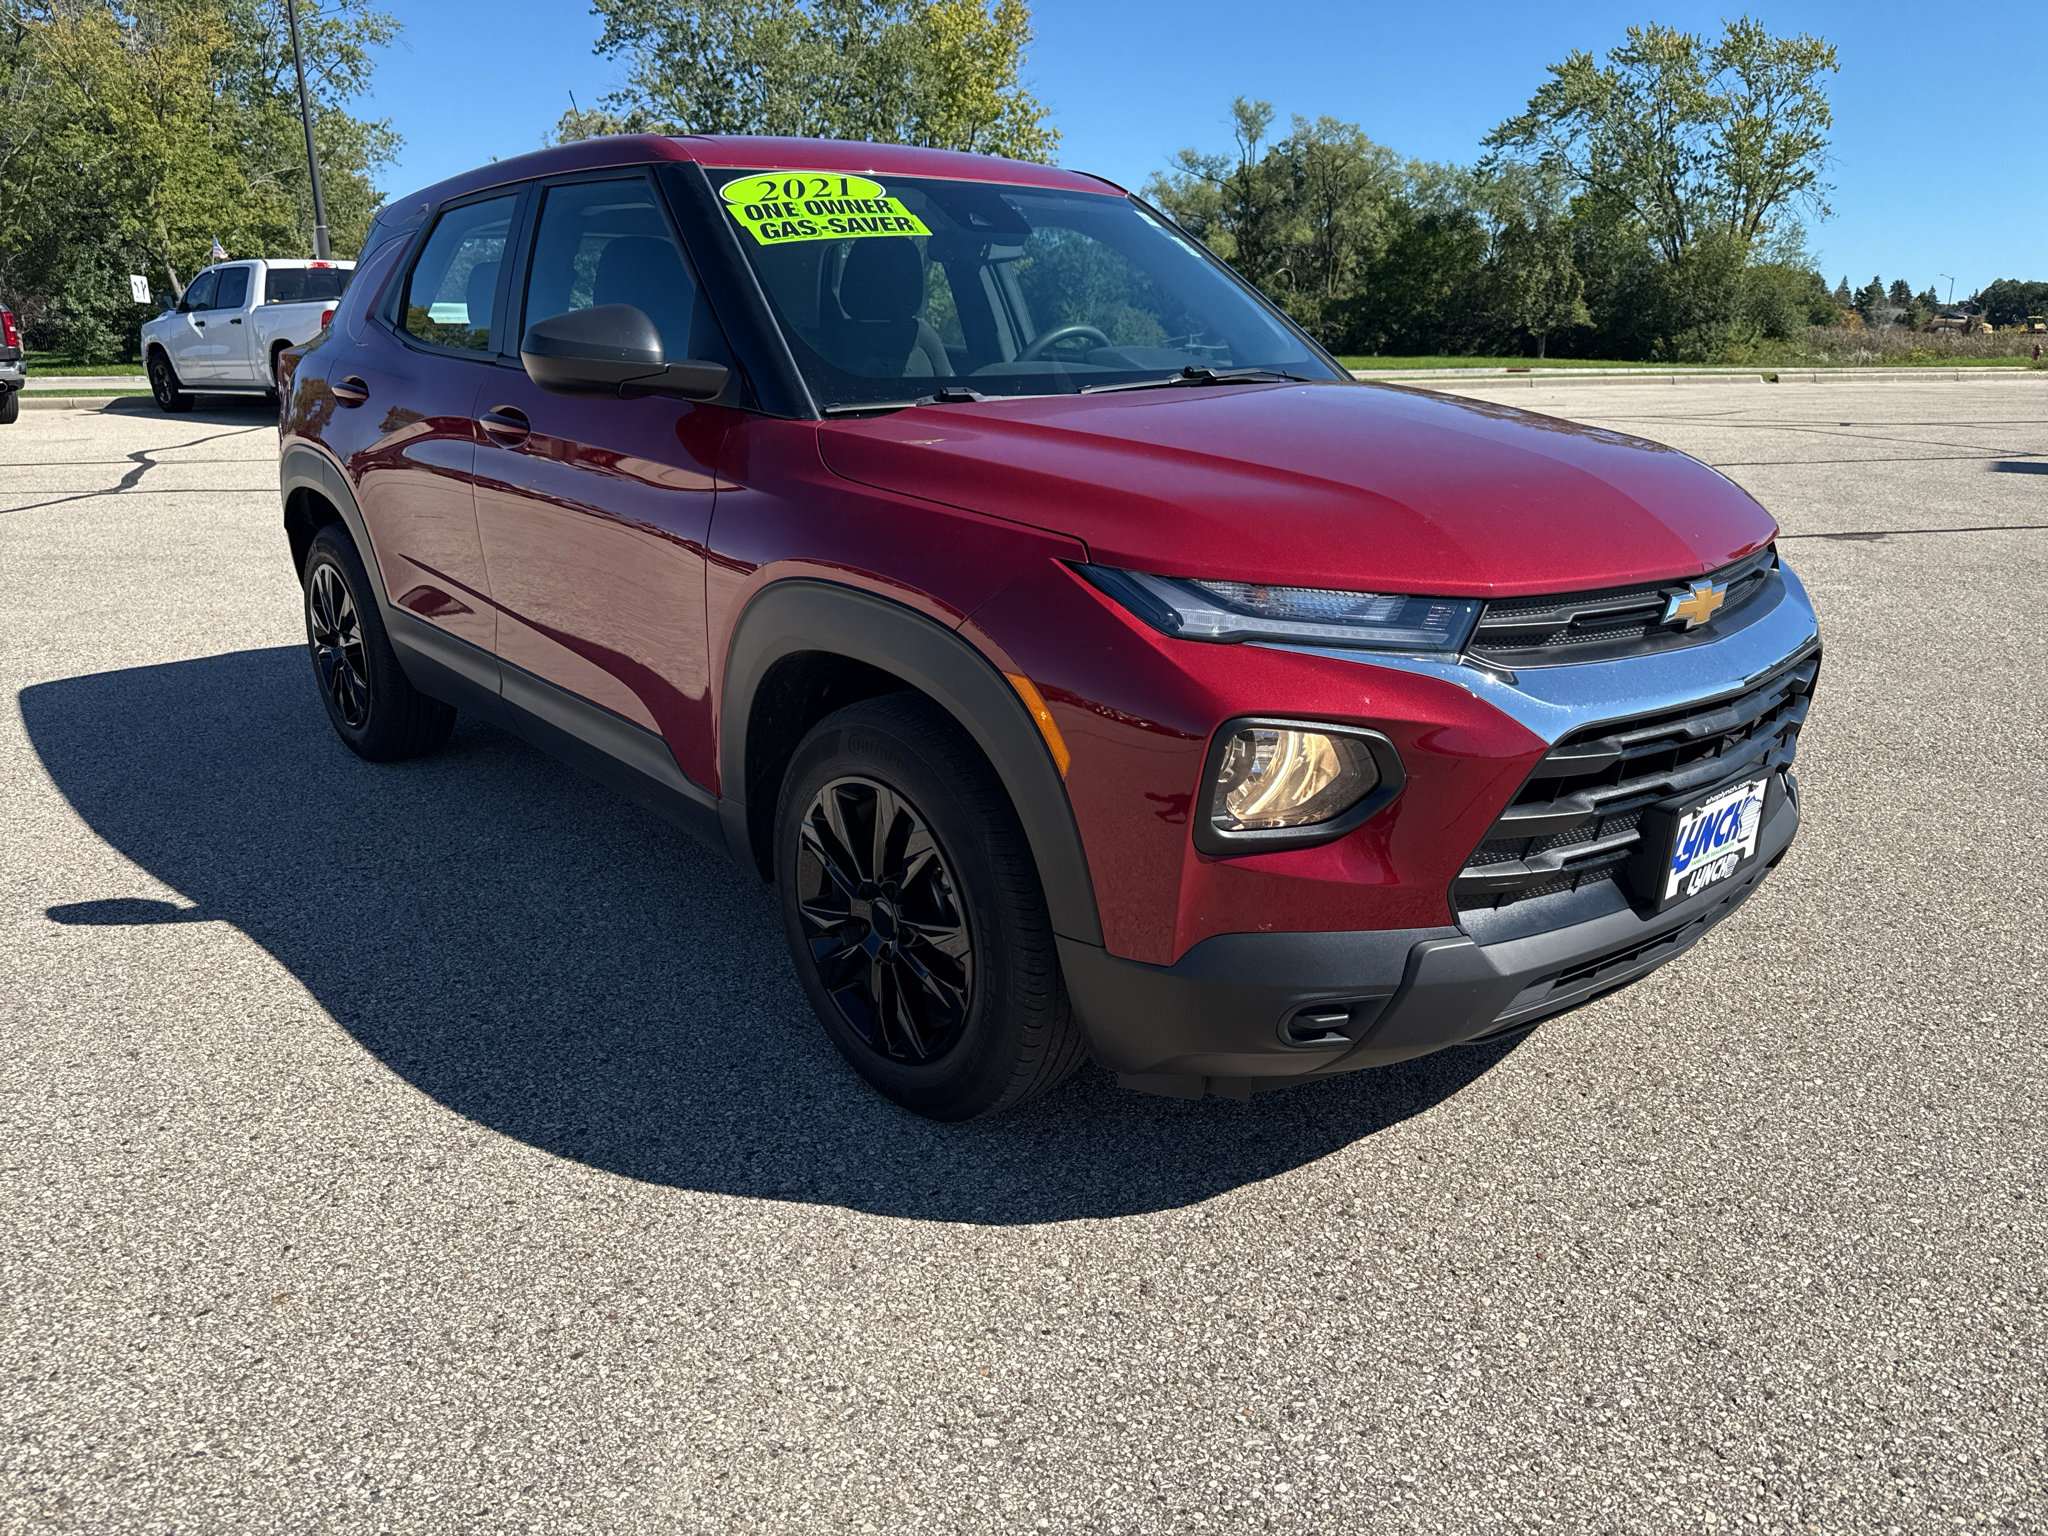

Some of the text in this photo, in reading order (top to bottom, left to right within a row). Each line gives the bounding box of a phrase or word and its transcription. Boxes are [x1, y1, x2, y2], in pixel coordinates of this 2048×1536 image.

[756, 178, 854, 202] 2021
[744, 198, 894, 221] ONE OWNER
[759, 216, 915, 240] GAS-SAVER
[1671, 796, 1749, 875] LYNCH
[1687, 855, 1731, 897] LYNCH
